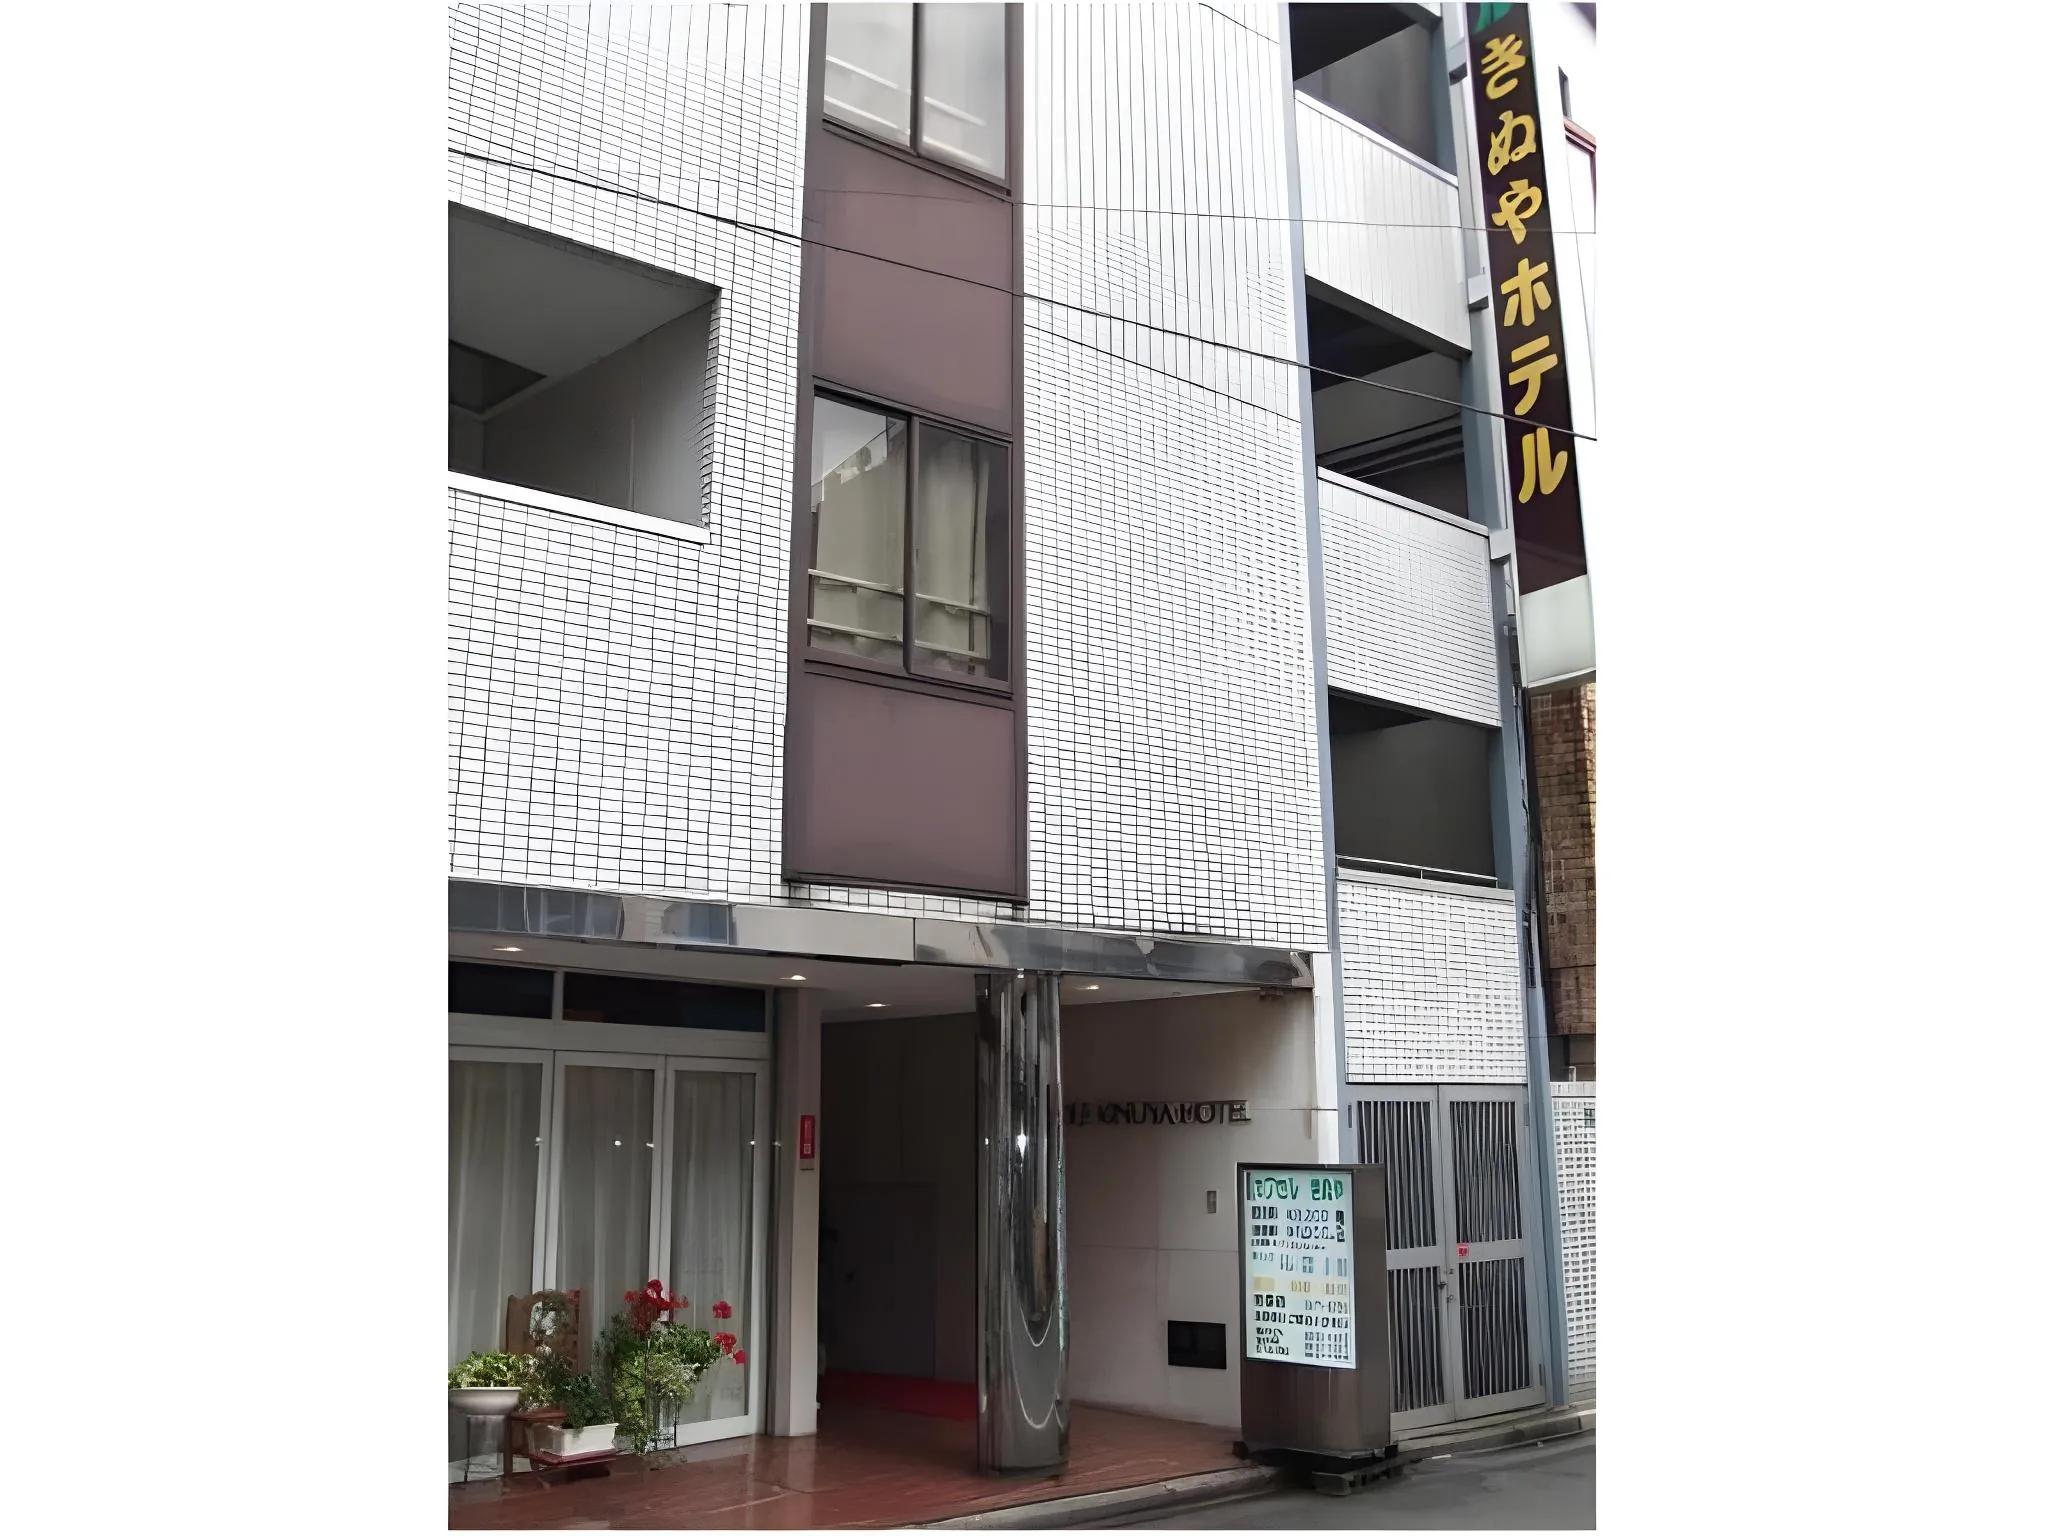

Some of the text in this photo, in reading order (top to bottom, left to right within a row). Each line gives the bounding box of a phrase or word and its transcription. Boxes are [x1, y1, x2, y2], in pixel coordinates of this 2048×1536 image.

[1481, 34, 1567, 503] きぬやホテル
